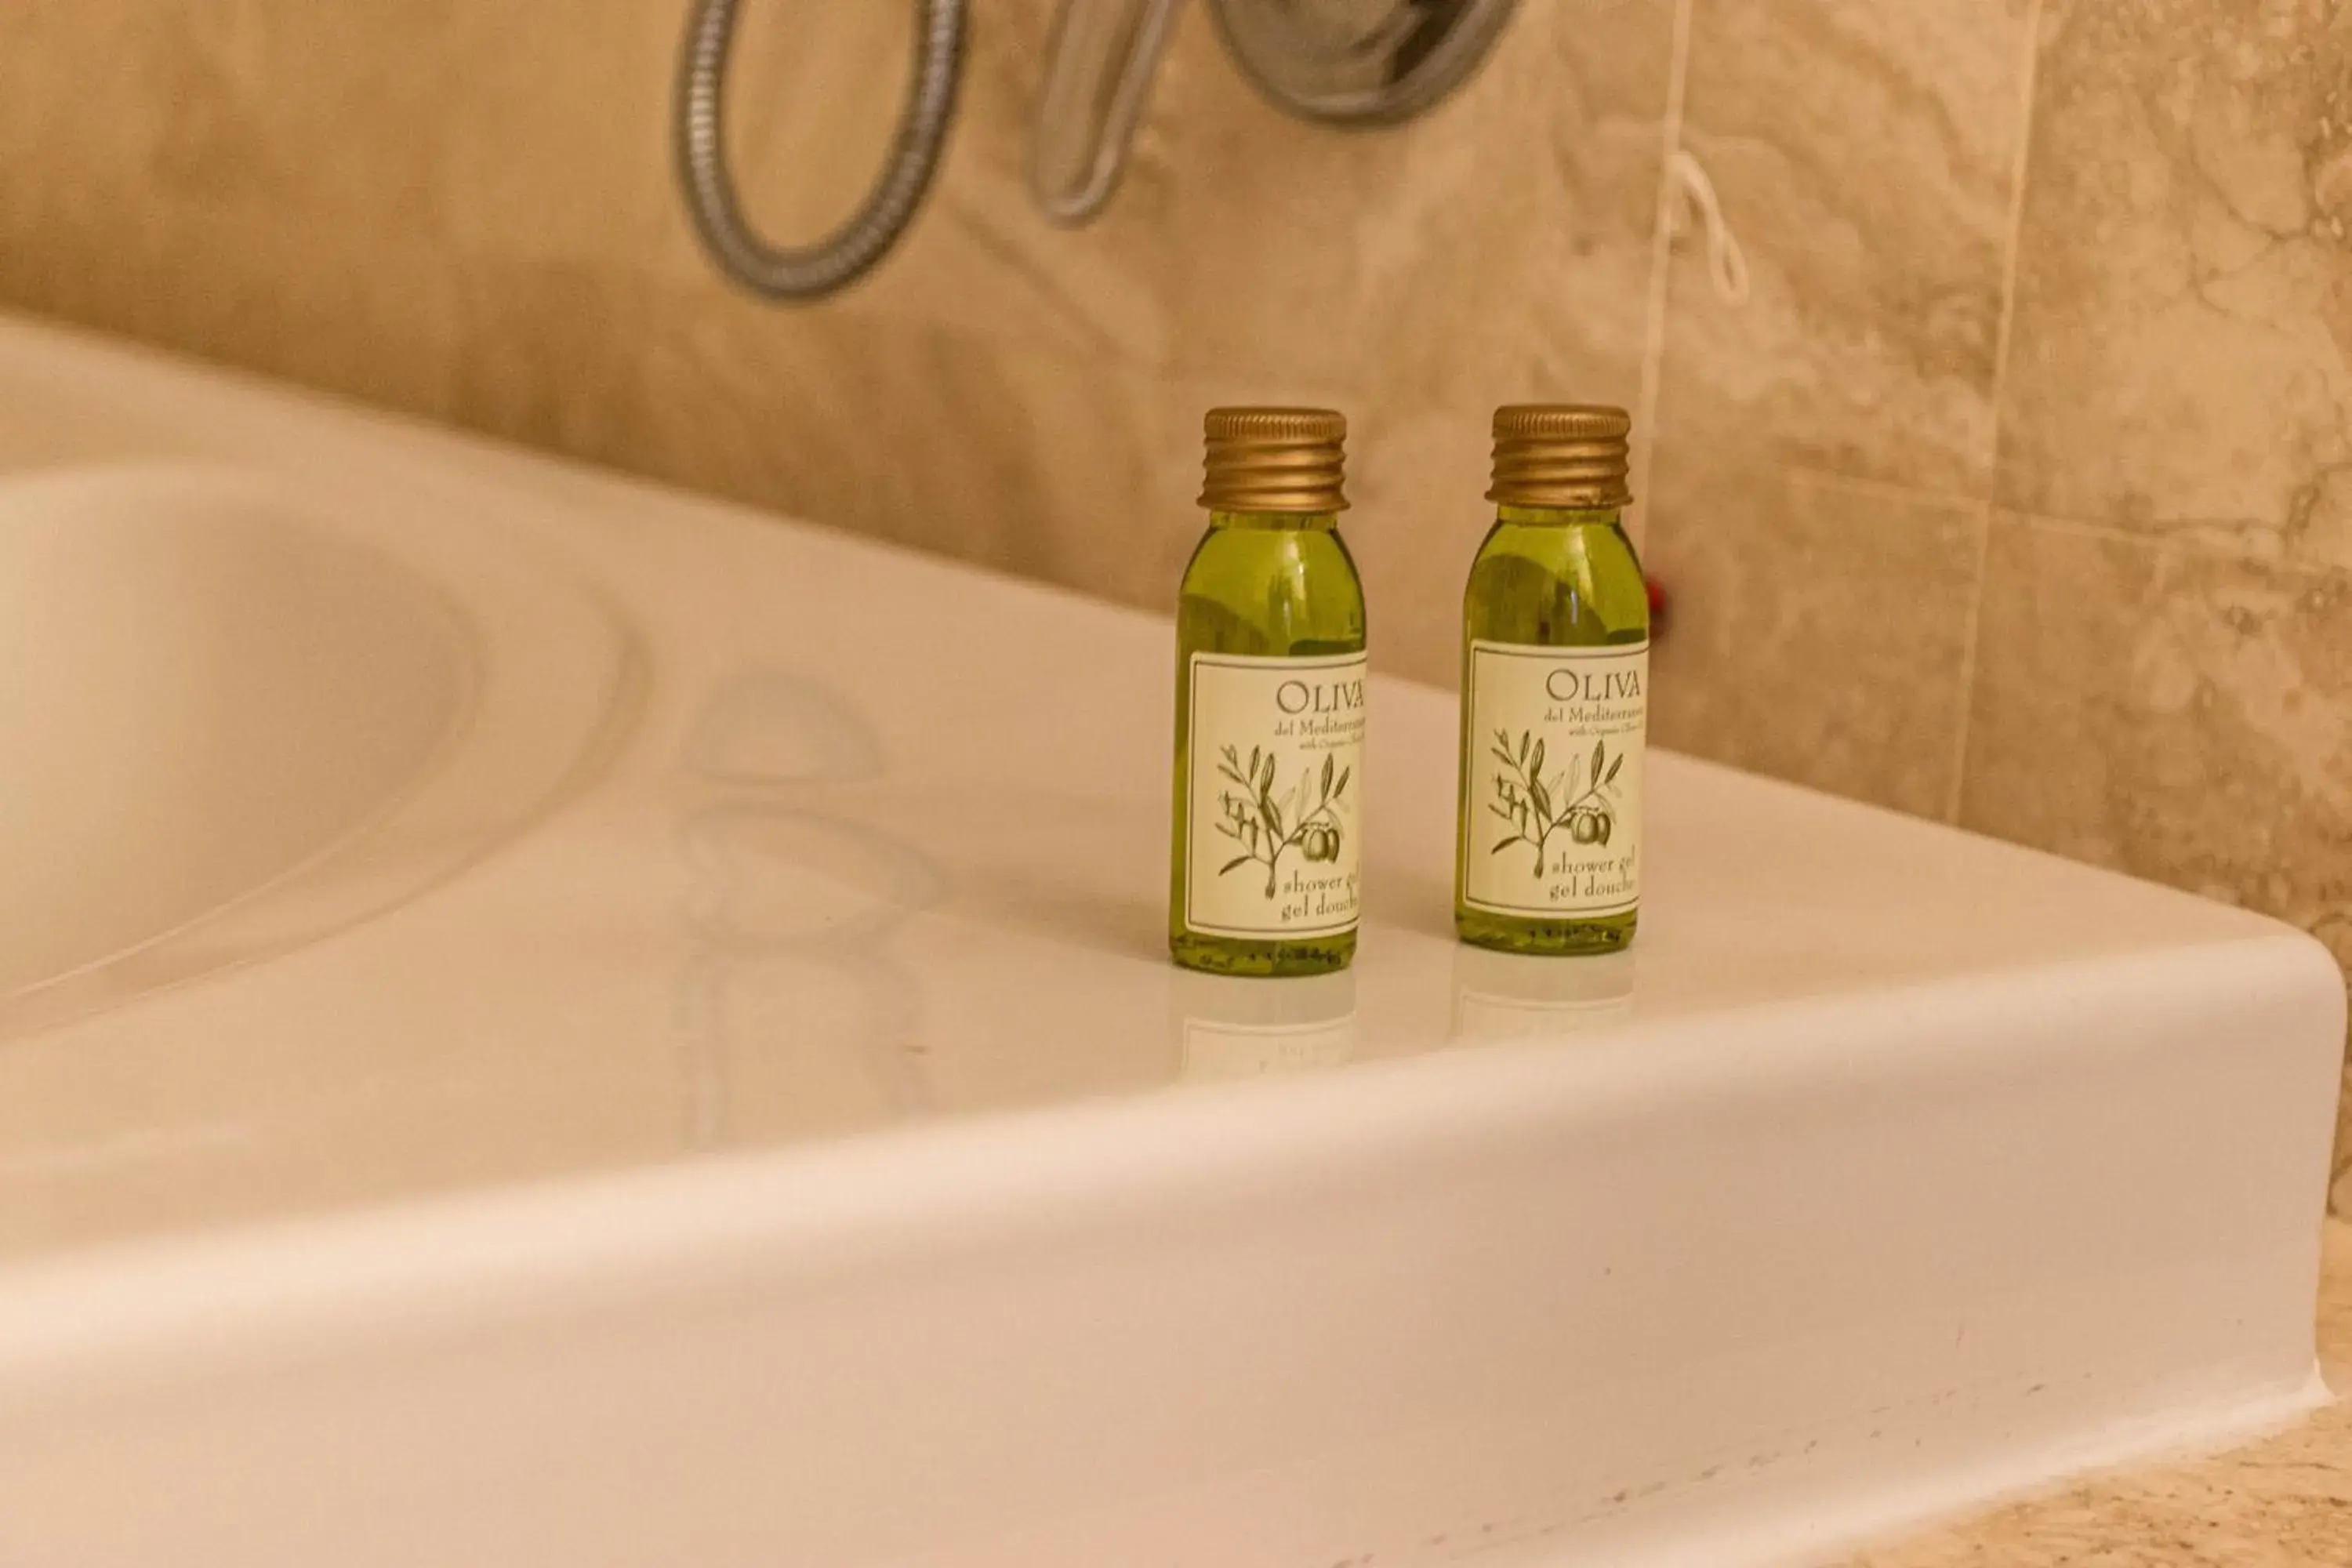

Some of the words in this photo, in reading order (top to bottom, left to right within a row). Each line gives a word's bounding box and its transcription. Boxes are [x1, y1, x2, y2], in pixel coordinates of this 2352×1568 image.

[1276, 679, 1364, 714] OLIVA
[1545, 668, 1640, 702] OLIVA
[1274, 720, 1294, 736] del
[1544, 706, 1563, 722] del
[1552, 851, 1614, 874] shower
[1619, 844, 1635, 874] gel
[1283, 869, 1343, 893] shower
[1549, 875, 1577, 902] gel
[1281, 894, 1308, 923] gel
